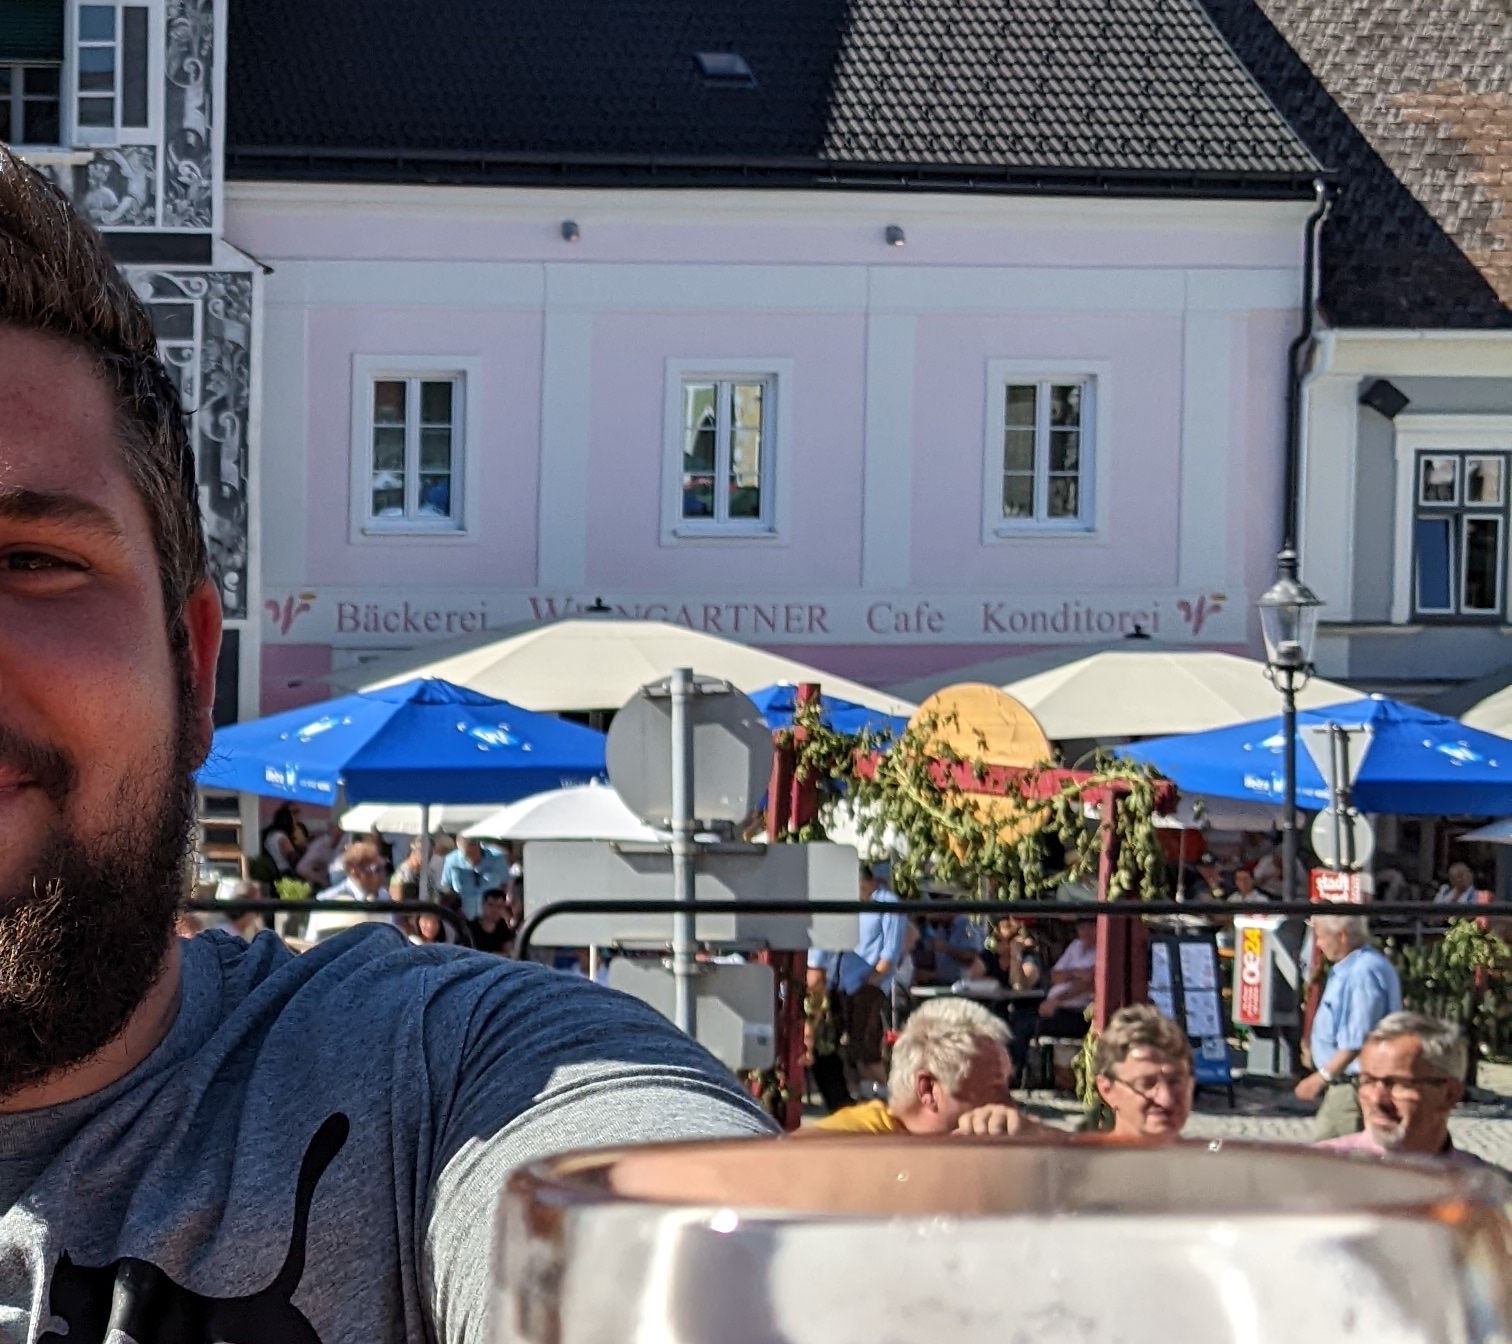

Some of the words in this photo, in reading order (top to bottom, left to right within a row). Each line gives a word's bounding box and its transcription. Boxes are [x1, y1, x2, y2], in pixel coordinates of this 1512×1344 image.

[336, 600, 488, 634] Bäckerei
[865, 600, 946, 635] Cafe
[981, 601, 1161, 634] Konditorei
